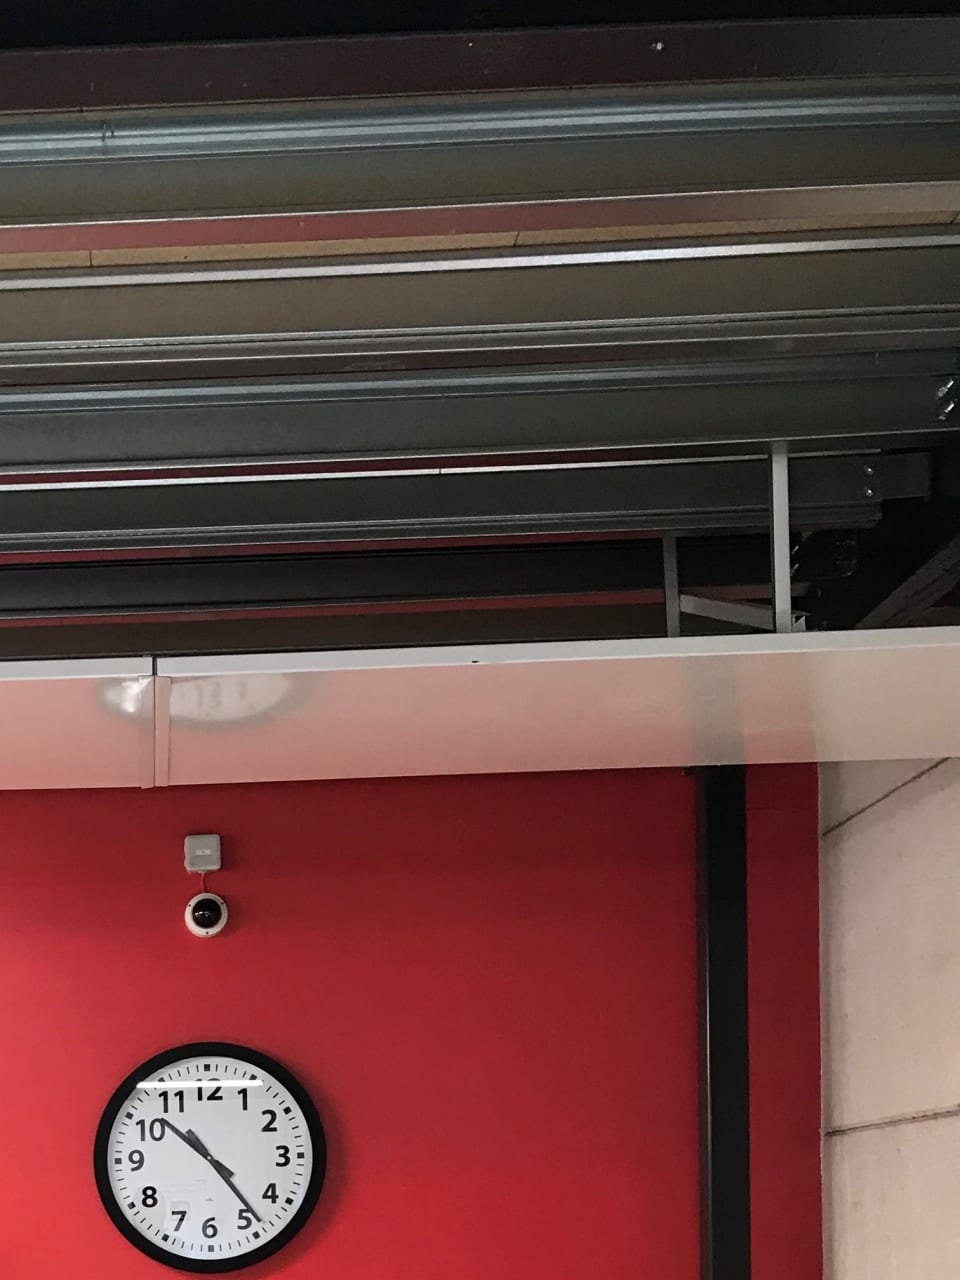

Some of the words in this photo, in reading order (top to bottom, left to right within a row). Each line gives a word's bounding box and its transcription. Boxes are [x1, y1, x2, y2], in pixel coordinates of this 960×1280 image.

[194, 1078, 223, 1101] 12
[237, 1088, 248, 1111] 1
[158, 1090, 185, 1113] 11
[135, 1118, 165, 1142] 10
[261, 1109, 278, 1132] 2
[128, 1149, 145, 1171] 9
[275, 1145, 292, 1167] 3
[141, 1186, 158, 1208] 8
[262, 1182, 279, 1204] 4
[171, 1210, 187, 1232] 7
[201, 1216, 219, 1239] 6
[237, 1208, 253, 1230] 5
